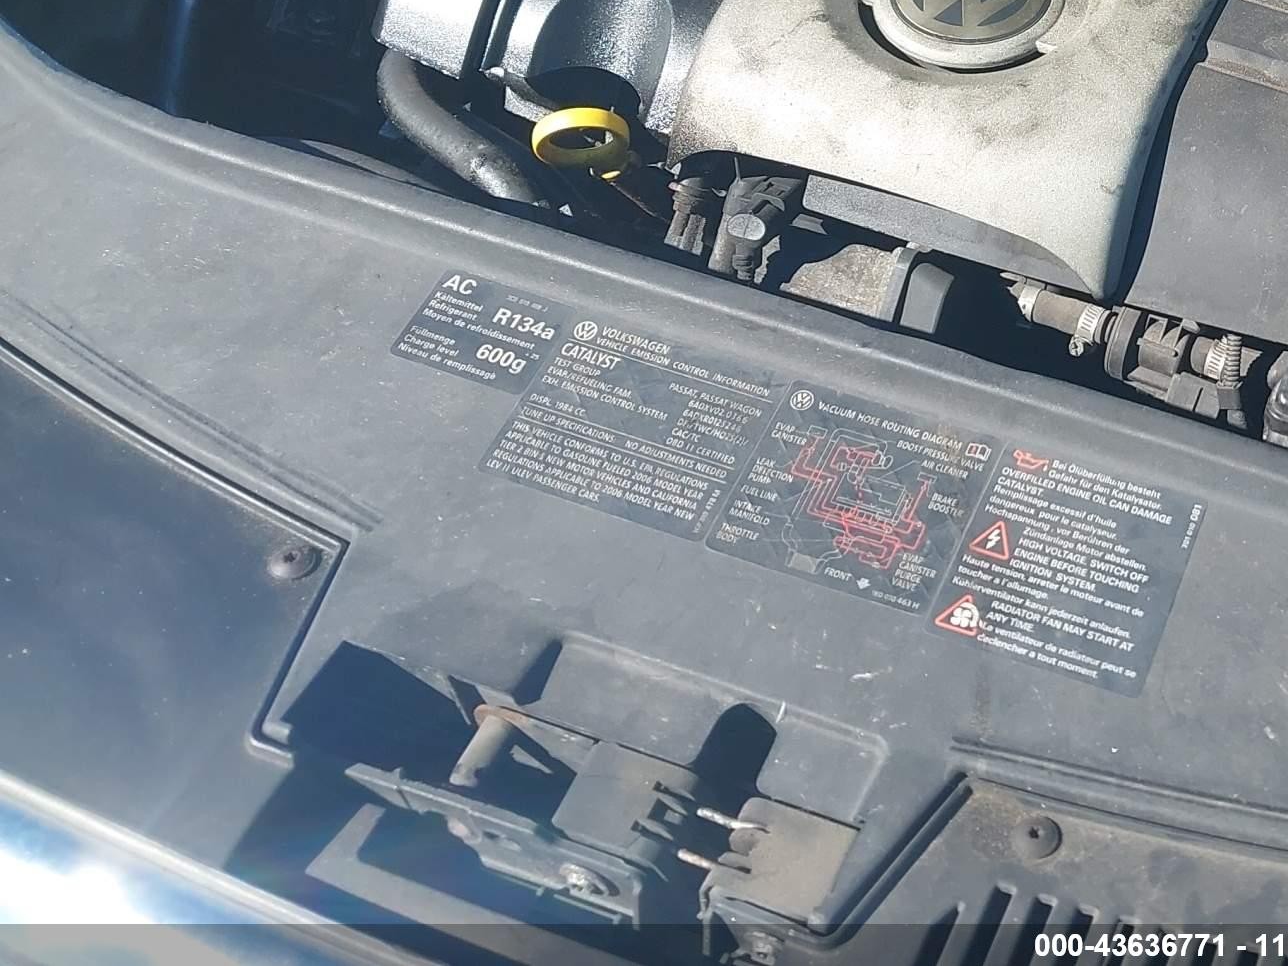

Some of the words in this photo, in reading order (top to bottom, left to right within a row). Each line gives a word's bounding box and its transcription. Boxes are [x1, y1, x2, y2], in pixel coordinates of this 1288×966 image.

[441, 274, 477, 294] AC
[427, 299, 477, 320] Refrigerant
[492, 307, 555, 339] R134a
[409, 325, 455, 345] Füllmenge
[422, 308, 452, 322] Moyen
[453, 319, 466, 327] de
[466, 323, 535, 349] refroidissement
[601, 326, 670, 354] VOLKSWAGEN
[397, 342, 428, 357] Niveau
[429, 353, 441, 361] de
[403, 334, 435, 349] Charge
[436, 344, 459, 356] level
[475, 343, 527, 374] 600g
[560, 342, 621, 369] CATALYST
[554, 357, 571, 367] TEST
[572, 363, 600, 376] GROUP
[596, 337, 628, 351] VEHICLE
[630, 348, 670, 365] EMISSION
[672, 361, 709, 377] CONTROL
[712, 373, 769, 396] INFORMATION
[554, 401, 573, 411] 1984
[574, 407, 585, 416] CC
[560, 381, 599, 398] EMISSION
[600, 393, 635, 410] CONTROL
[637, 405, 667, 419] SYSTEM
[699, 392, 728, 405] PASSAT
[729, 401, 761, 416] WAGON
[771, 429, 806, 445] CANISTER
[775, 422, 795, 432] EVAP
[818, 401, 856, 418] VACUUM
[856, 413, 880, 426] HOSE
[881, 420, 920, 437] ROUTING
[921, 431, 962, 450] DIAGRAM
[520, 406, 542, 418] TUNE
[625, 440, 638, 449] NO
[638, 445, 694, 467] ADJUSTMENTS
[694, 462, 726, 477] NEEDED
[665, 437, 684, 447] OBD
[695, 446, 735, 464] CERTIFIED
[505, 430, 549, 449] APPLICABLE
[550, 444, 561, 453] TO
[562, 449, 601, 467] GASOLINE
[601, 461, 631, 476] FUELED
[631, 471, 652, 483] 2006
[653, 478, 681, 493] MODEL
[683, 487, 703, 499] YEAR
[512, 421, 529, 432] THIS
[531, 427, 562, 442] VEHICLE
[563, 438, 608, 457] CONFORMS
[609, 452, 621, 461] TO
[654, 467, 708, 490] REGULATIONS
[756, 457, 775, 467] LEAK
[896, 440, 923, 452] BOOST
[960, 458, 984, 471] VALVE
[921, 459, 934, 468] AIR
[935, 463, 968, 478] CLEANER
[486, 459, 502, 468] LEV
[511, 467, 532, 478] ULEV
[532, 473, 577, 493] PASSENGER
[492, 449, 544, 471] REGULATIONS
[544, 466, 590, 486] APPLICABLE
[590, 480, 601, 490] TO
[602, 485, 622, 497] 2006
[623, 491, 651, 507] MODEL
[653, 501, 673, 513] YEAR
[673, 508, 694, 519] NEW
[499, 439, 516, 450] TIER
[523, 448, 538, 457] BIN
[545, 454, 565, 466] NEW
[565, 461, 594, 476] MOTOR
[596, 471, 631, 488] VEHICLES
[631, 483, 650, 494] AND
[651, 489, 696, 509] CALIFORNIA
[748, 472, 771, 484] PUMP
[752, 464, 793, 482] DETECTION
[1052, 460, 1067, 470] Bei
[1127, 482, 1160, 498] besteht
[740, 484, 759, 496] FUEL
[759, 490, 777, 501] LINE
[931, 492, 957, 506] BRAKE
[993, 484, 1048, 507] Remplissage
[1049, 503, 1086, 518] excessif
[1001, 467, 1055, 488] OVERFILLED
[1056, 483, 1091, 499] ENGINE
[1092, 494, 1107, 504] OIL
[1108, 499, 1129, 511] CAN
[1130, 505, 1171, 524] DAMAGE
[1048, 469, 1077, 483] Gefahr
[1093, 483, 1110, 494] den
[1111, 488, 1161, 509] Katalysator.
[729, 507, 769, 525] MANIFOLD
[734, 499, 761, 513] INTAKE
[989, 494, 1035, 514] dangereux
[1038, 511, 1059, 521] pour
[1060, 516, 1069, 524] le
[1070, 520, 1116, 540] catalyseur.
[721, 522, 758, 540] THROTTLE
[984, 504, 1050, 530] Hochspannung
[1056, 527, 1071, 535] vor
[1114, 544, 1129, 554] der
[898, 560, 936, 578] CANISTER
[1014, 548, 1048, 564] ENGINE
[1050, 559, 1087, 576] BEFORE
[1089, 570, 1139, 592] TOUCHING
[1018, 537, 1043, 550] HIGH
[1089, 559, 1128, 577] SWITCH
[1129, 571, 1148, 582] OFF
[1075, 543, 1103, 557] Motor
[1104, 553, 1146, 570] abstellen.
[824, 567, 851, 580] FRONT
[894, 568, 921, 583] PURGE
[958, 565, 992, 580] toucher
[962, 554, 989, 568] Haute
[1059, 584, 1069, 593] le
[1070, 589, 1103, 603] moteur
[1104, 600, 1130, 612] avant
[1131, 608, 1143, 616] de
[1009, 558, 1052, 577] IGNITION
[1055, 572, 1096, 591] SYSTEM.
[985, 611, 1008, 623] ANY
[991, 600, 1040, 621] RADIATOR
[1041, 616, 1061, 628] FAN
[1062, 623, 1085, 635] MAY
[1086, 630, 1119, 646] START
[1119, 641, 1134, 651] AT
[1024, 599, 1047, 611] kann
[1047, 606, 1088, 625] jederzeit
[1089, 620, 1130, 638] anlaufen.
[994, 627, 1043, 647] ventilateur
[1044, 643, 1056, 652] de
[1058, 648, 1100, 665] radiateur
[1100, 662, 1123, 673] peut
[1124, 669, 1136, 677] se
[1037, 653, 1056, 664] tout
[1057, 660, 1097, 678] moment.
